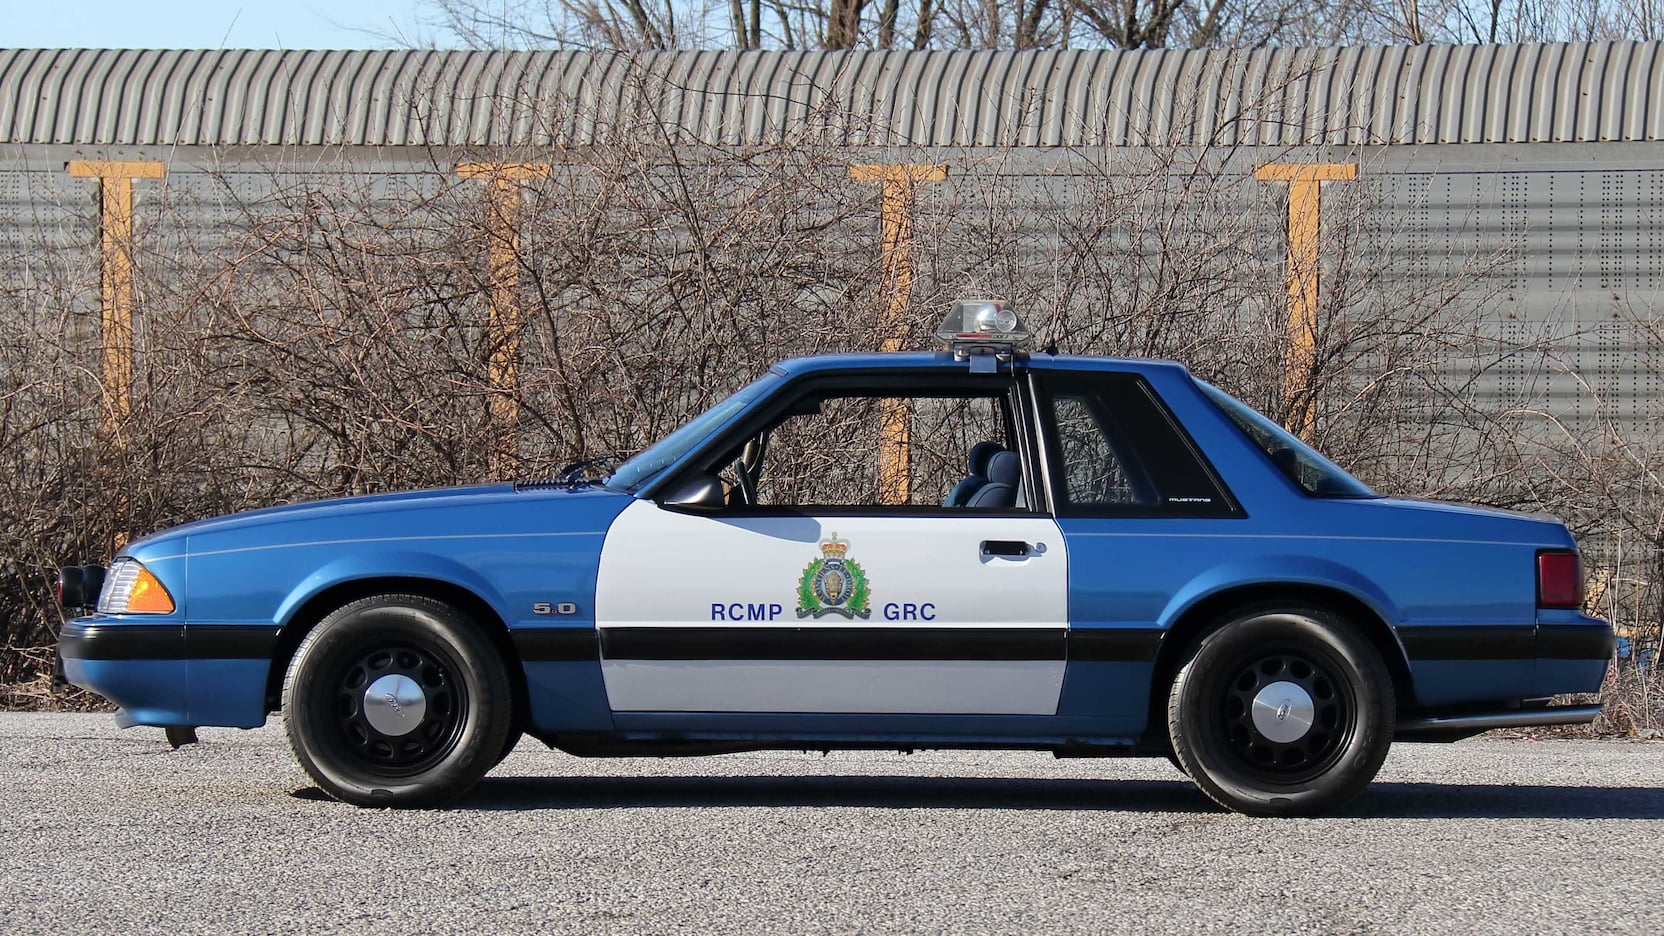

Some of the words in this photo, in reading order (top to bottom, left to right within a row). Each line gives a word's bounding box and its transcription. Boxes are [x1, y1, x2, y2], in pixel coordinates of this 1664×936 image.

[533, 602, 576, 614] 5.0
[711, 603, 783, 621] RCMP
[883, 603, 936, 621] GRC
